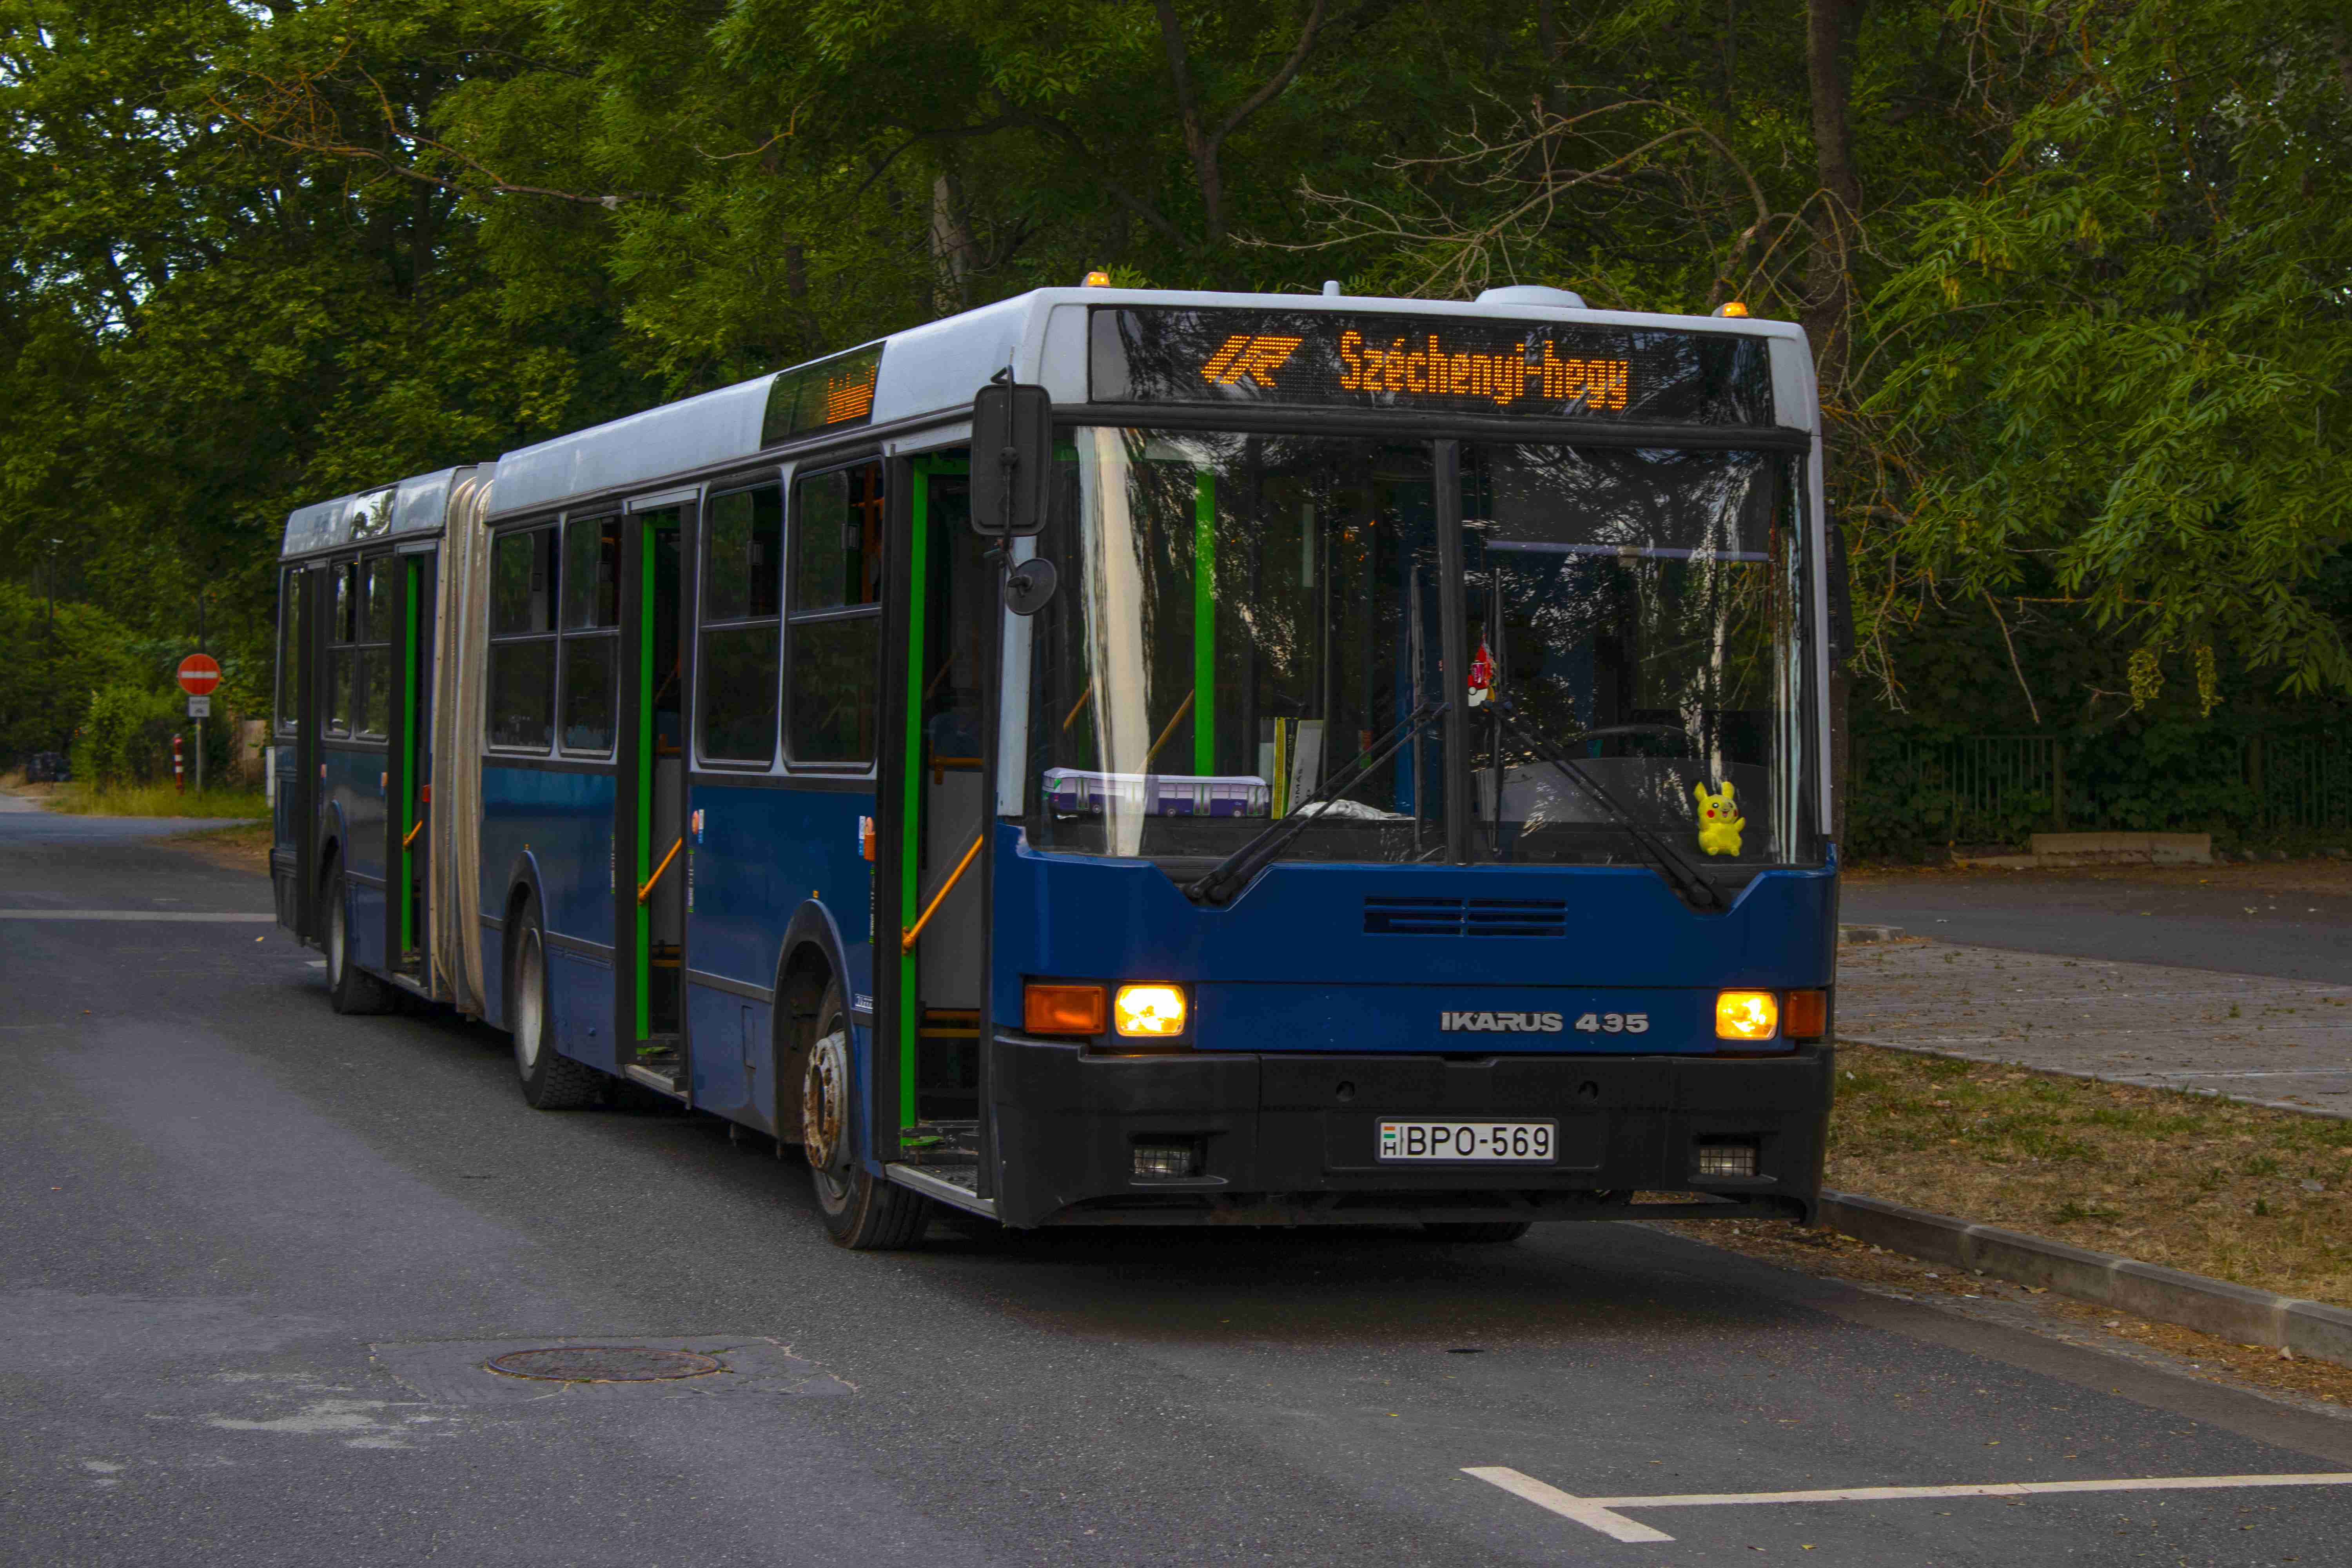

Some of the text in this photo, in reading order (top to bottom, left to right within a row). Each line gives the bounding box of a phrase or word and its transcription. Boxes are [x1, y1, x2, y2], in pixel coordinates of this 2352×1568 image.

[1341, 331, 1627, 408] Széchenyi-hegy
[1441, 1012, 1649, 1033] IKARUS 435
[1383, 1126, 1549, 1156] H BPO-569
